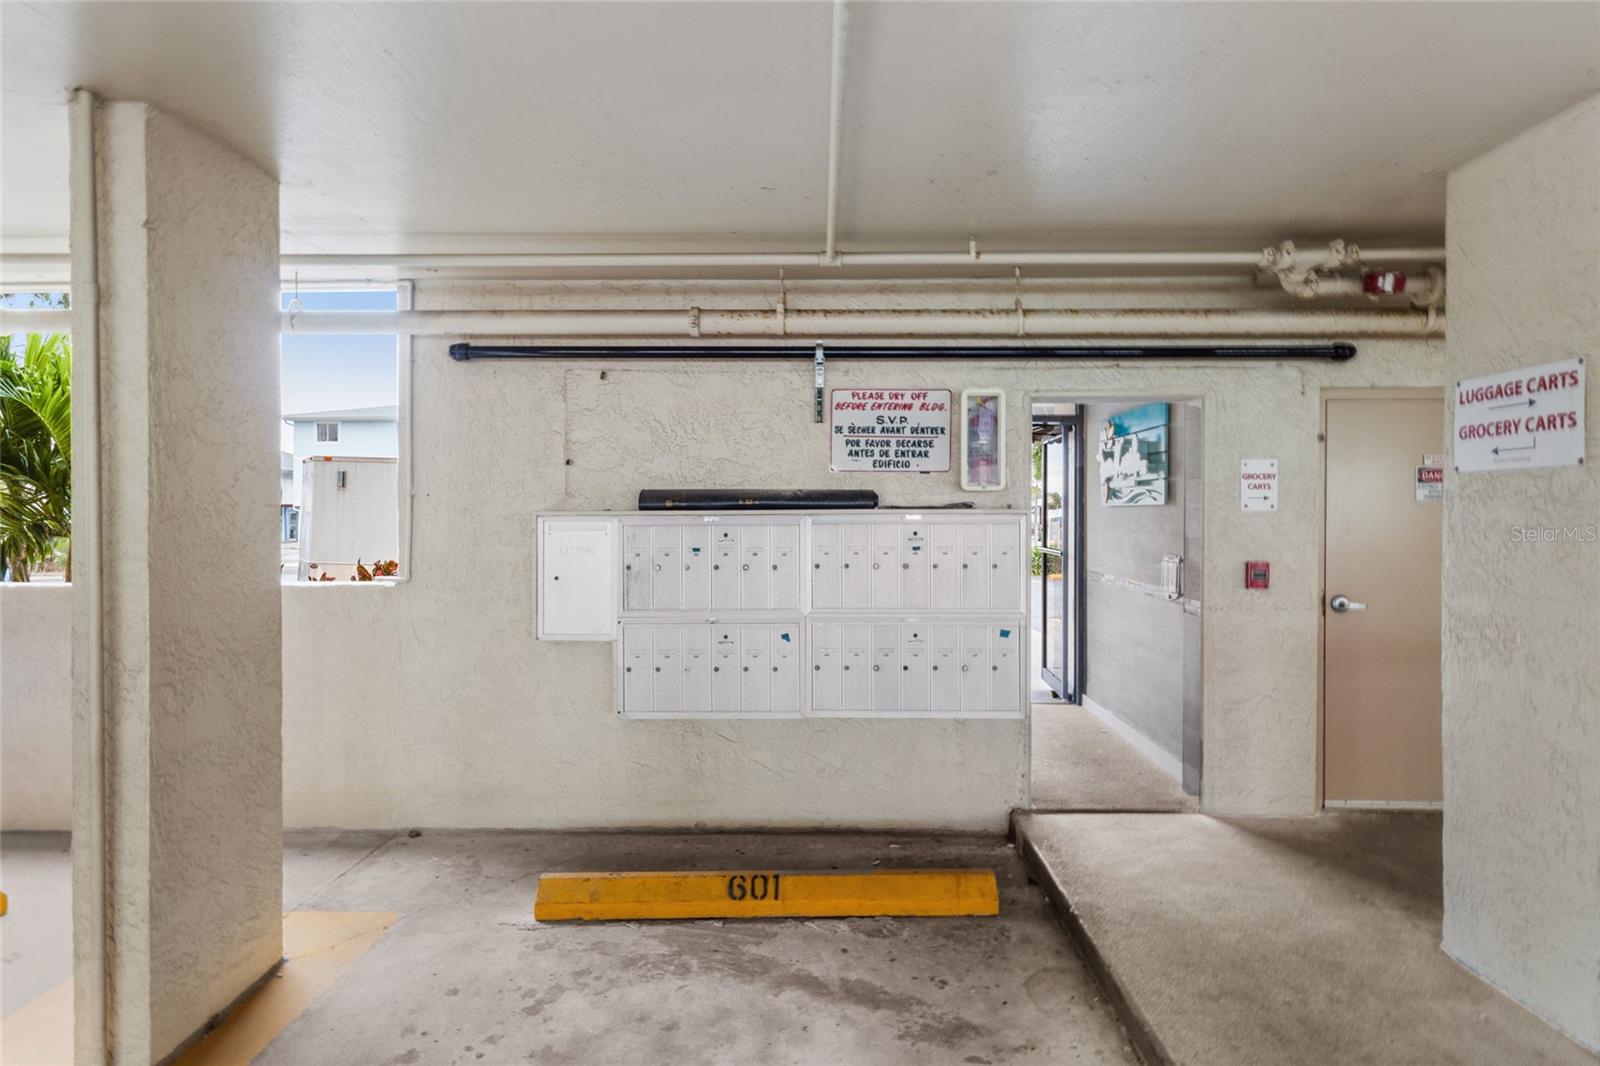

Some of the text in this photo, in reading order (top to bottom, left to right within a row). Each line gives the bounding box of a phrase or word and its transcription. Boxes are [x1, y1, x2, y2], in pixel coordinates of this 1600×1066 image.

[1459, 370, 1579, 405] LUGGAGE CARTS
[851, 391, 929, 400] PLEASE DRY OFF
[834, 401, 948, 411] BEFORE ENTERING BLDG.
[876, 415, 909, 425] S.V.P.
[834, 425, 844, 434] SE
[880, 426, 906, 435] AVANT
[1458, 411, 1578, 440] GROCERY CARTS
[845, 439, 861, 448] POR
[865, 439, 892, 448] FAVOR
[847, 449, 930, 459] ANTES DE ENTRAR
[872, 459, 911, 469] EDIFICIO
[1422, 471, 1443, 481] DAN
[728, 874, 780, 901] 601
